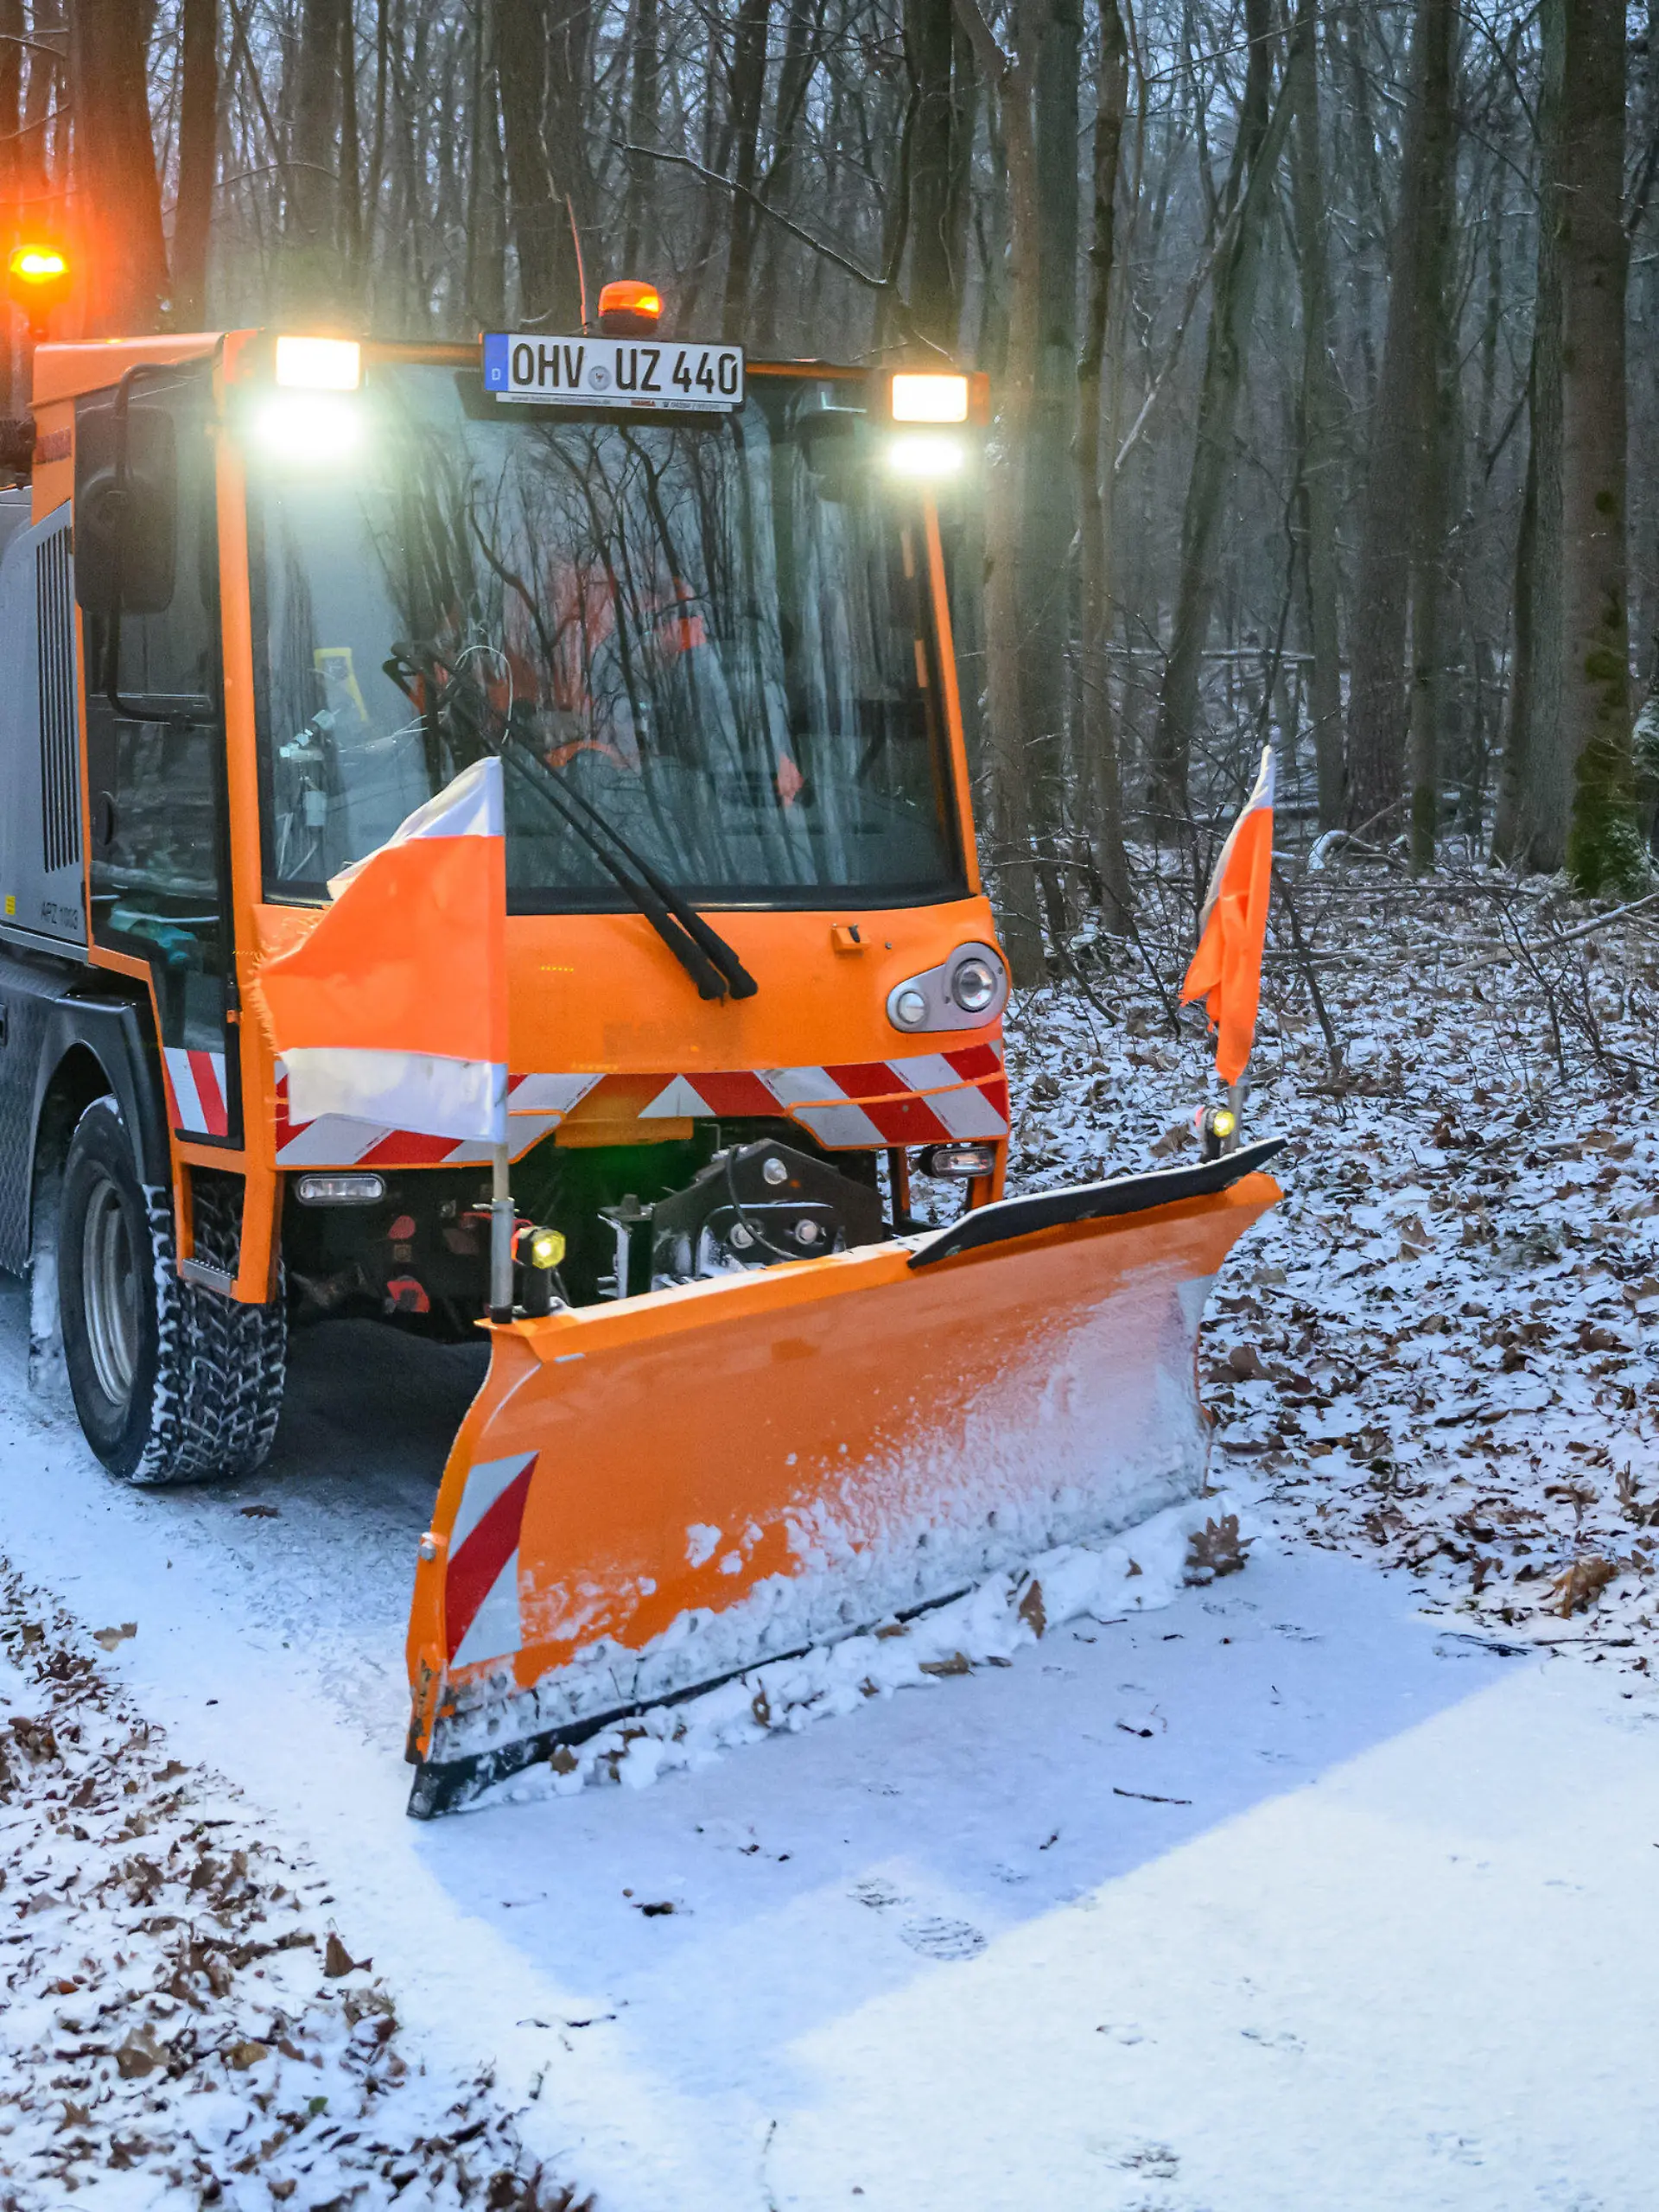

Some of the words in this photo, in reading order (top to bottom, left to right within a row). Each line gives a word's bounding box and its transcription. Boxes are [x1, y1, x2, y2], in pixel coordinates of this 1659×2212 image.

[491, 368, 501, 380] D
[512, 343, 585, 388] OHV
[616, 348, 661, 391] UZ
[672, 351, 737, 394] 440
